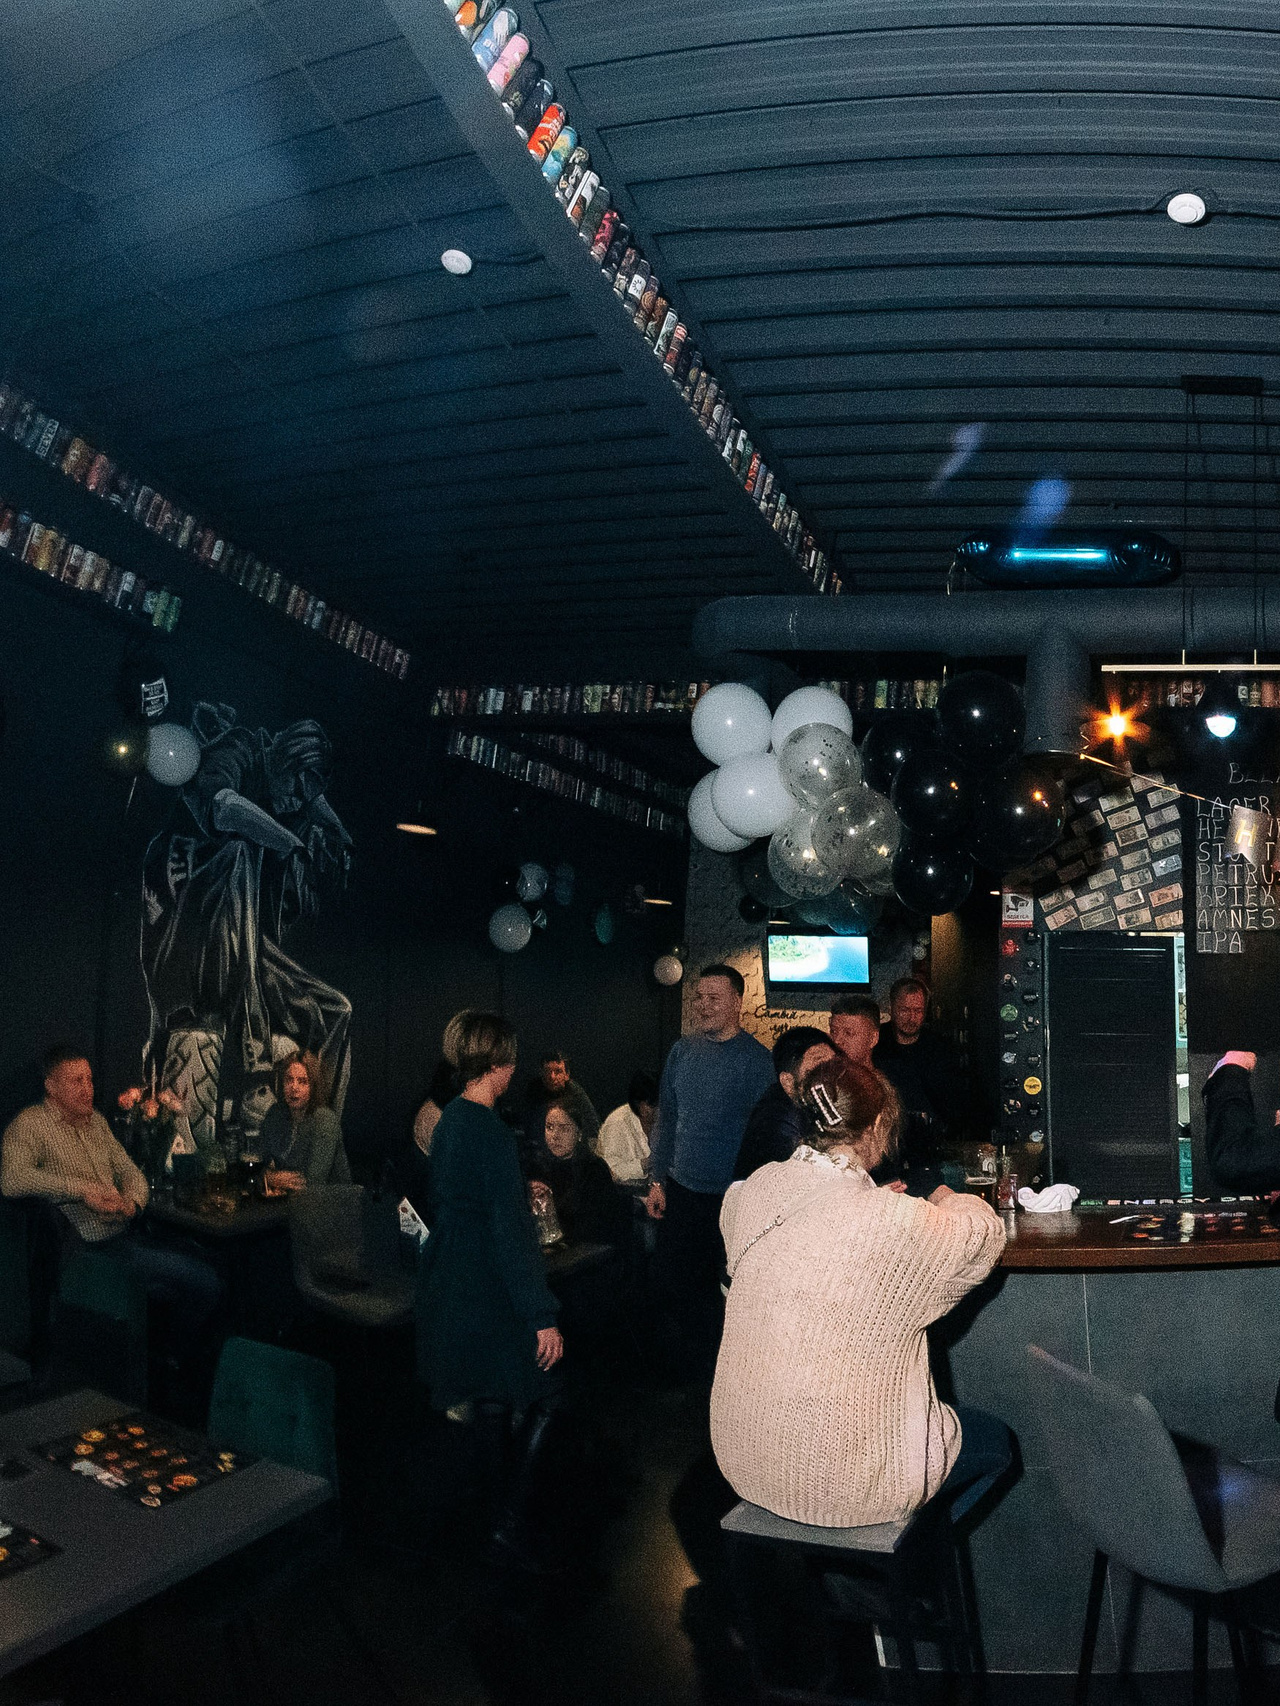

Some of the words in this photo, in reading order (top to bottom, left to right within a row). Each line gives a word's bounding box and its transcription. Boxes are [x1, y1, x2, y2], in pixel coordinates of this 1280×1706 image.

[1197, 841, 1276, 862] STT
[1197, 885, 1276, 907] KRIEK
[1197, 931, 1243, 954] IPA
